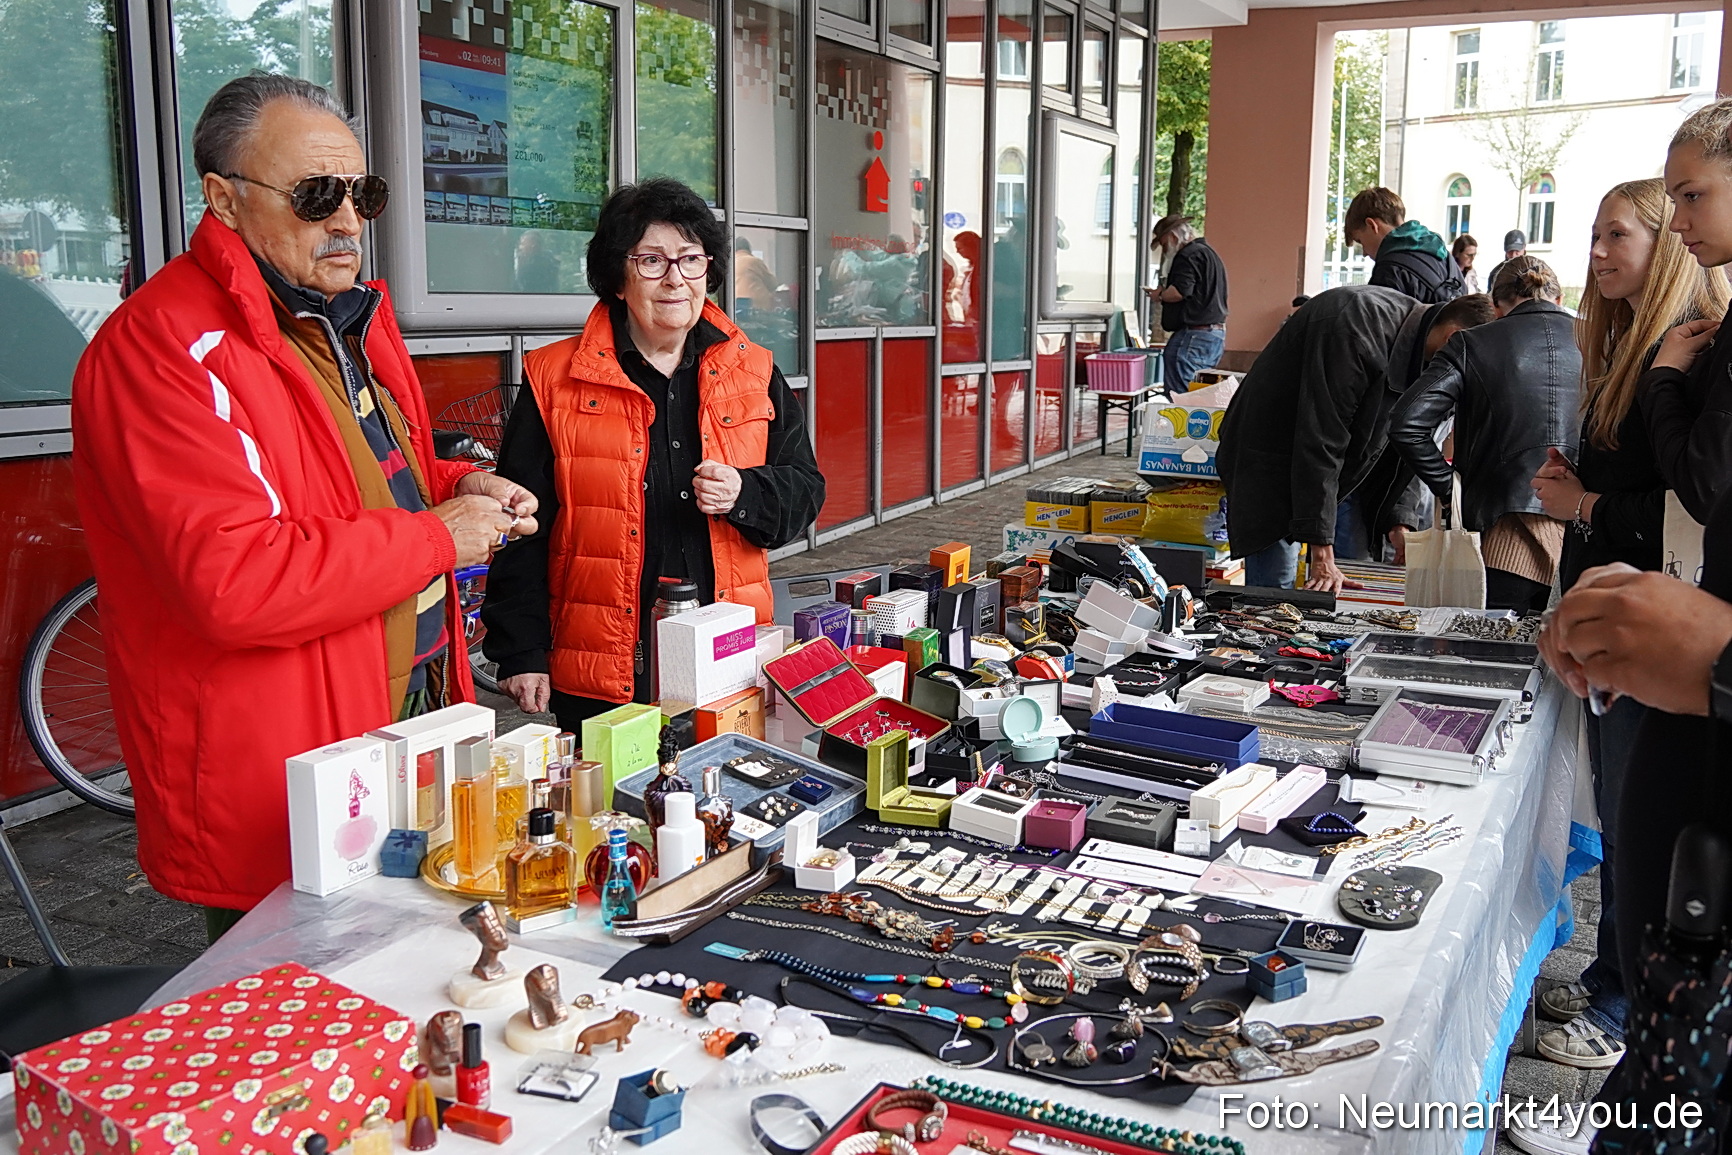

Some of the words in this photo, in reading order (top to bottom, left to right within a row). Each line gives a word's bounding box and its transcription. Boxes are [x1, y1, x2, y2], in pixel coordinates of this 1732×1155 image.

[462, 51, 472, 62] 02
[482, 55, 501, 67] 09:41
[1145, 460, 1192, 472] BANANAS
[1036, 508, 1071, 522] HENLEIN
[1103, 508, 1139, 524] HENGLEIN
[725, 631, 743, 644] MISS
